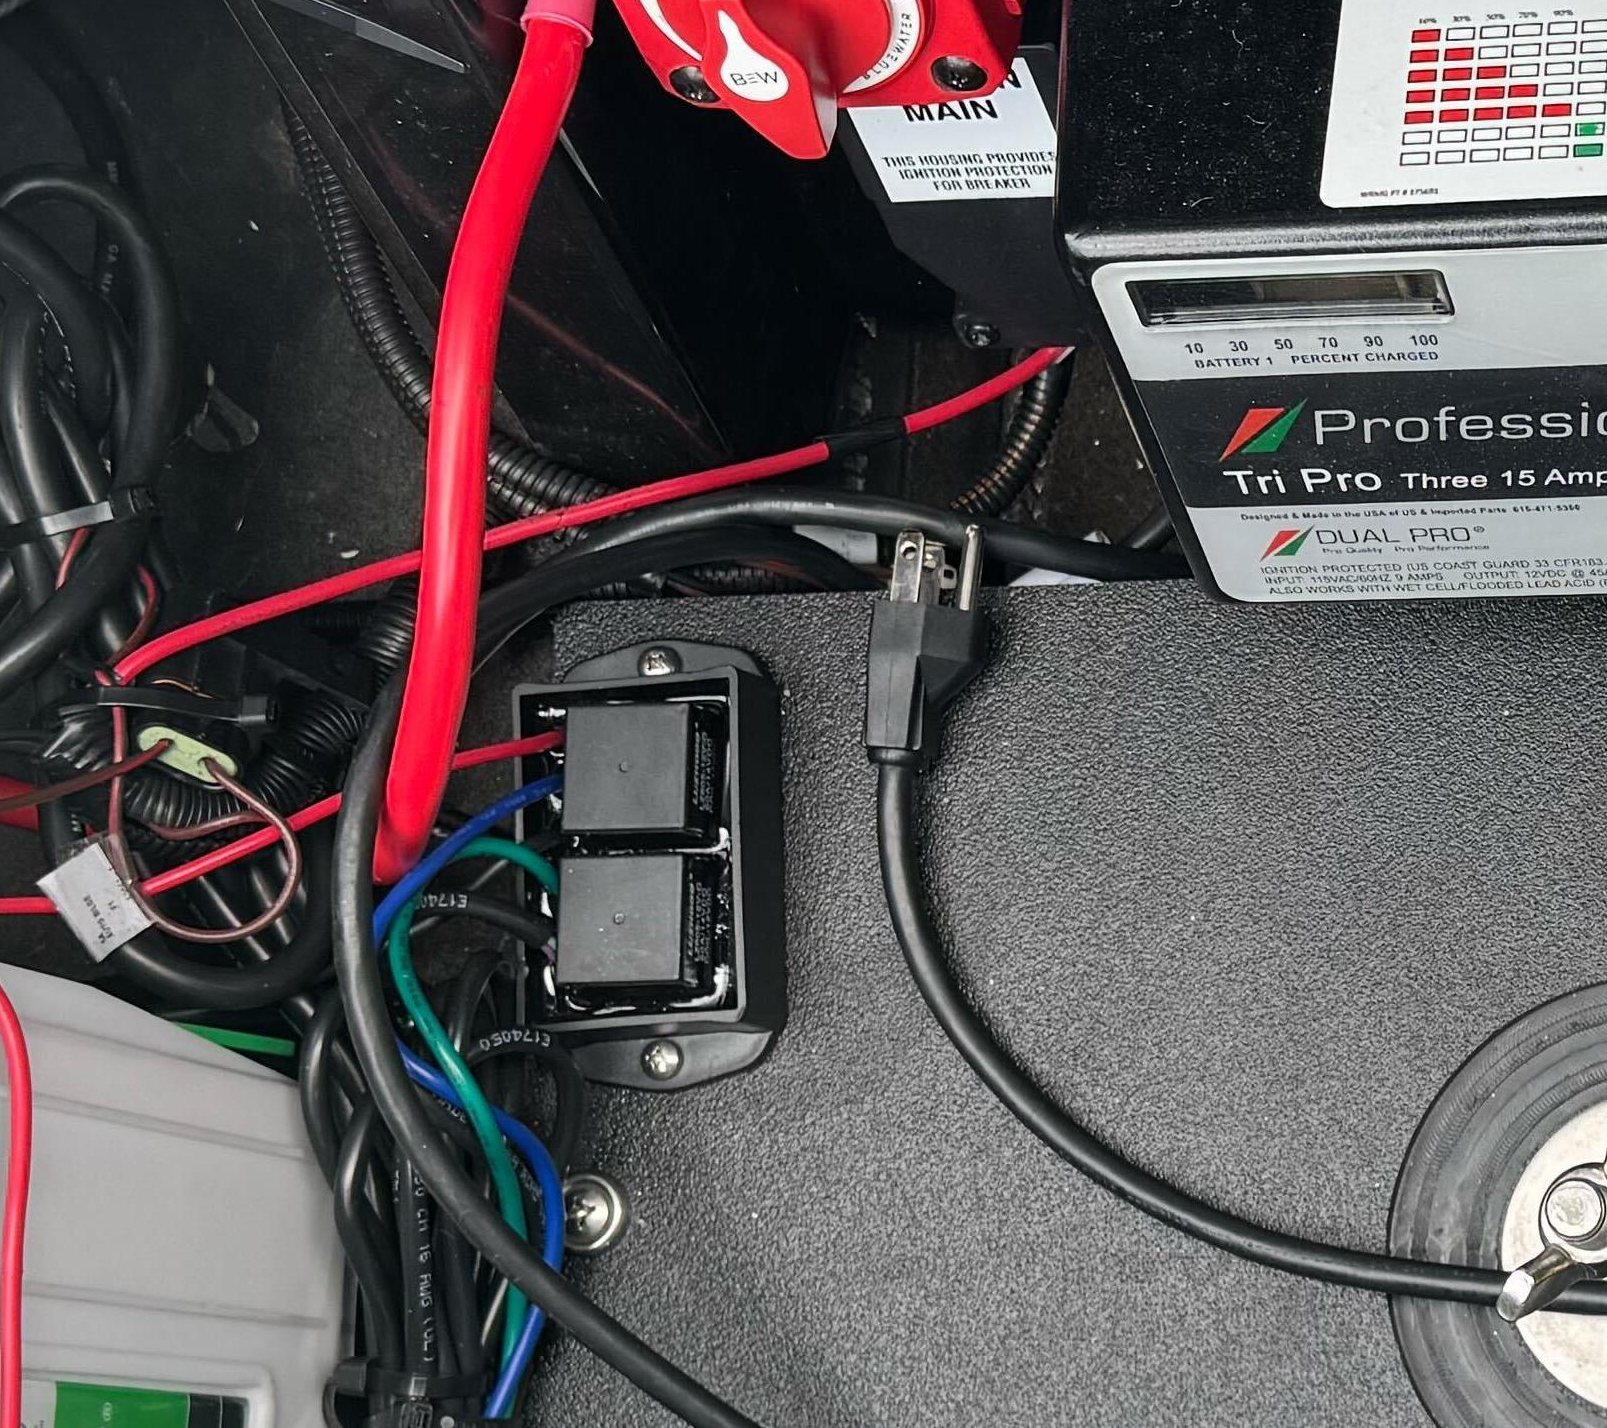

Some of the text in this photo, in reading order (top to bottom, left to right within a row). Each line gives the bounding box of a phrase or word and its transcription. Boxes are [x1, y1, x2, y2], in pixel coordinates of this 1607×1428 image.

[902, 99, 999, 122] MAIN
[882, 155, 915, 168] THIS
[919, 154, 983, 166] HOUSING
[899, 165, 1053, 180] IGNITION PROTECTION
[934, 178, 1031, 192] FOR BREAKER
[1185, 334, 1438, 355] 10 30 50 70 90 100
[1194, 351, 1439, 369] BATTERY 1 PERCENT CHARGED
[1223, 468, 1285, 495] Tri
[1300, 467, 1382, 493] Pro
[1401, 472, 1488, 489] Three
[1501, 469, 1536, 487] 15
[1316, 528, 1400, 544] DUAL
[1322, 564, 1402, 572] PROTECTED
[1433, 561, 1478, 570] COAST
[1483, 560, 1530, 569] GUARD
[1535, 560, 1549, 568] 33
[1307, 585, 1355, 593] WORKS
[1359, 584, 1391, 592] WITH
[1394, 583, 1422, 591] WET
[1528, 579, 1561, 588] LEAD
[1565, 579, 1595, 587] ACID
[479, 1030, 551, 1052] E174050
